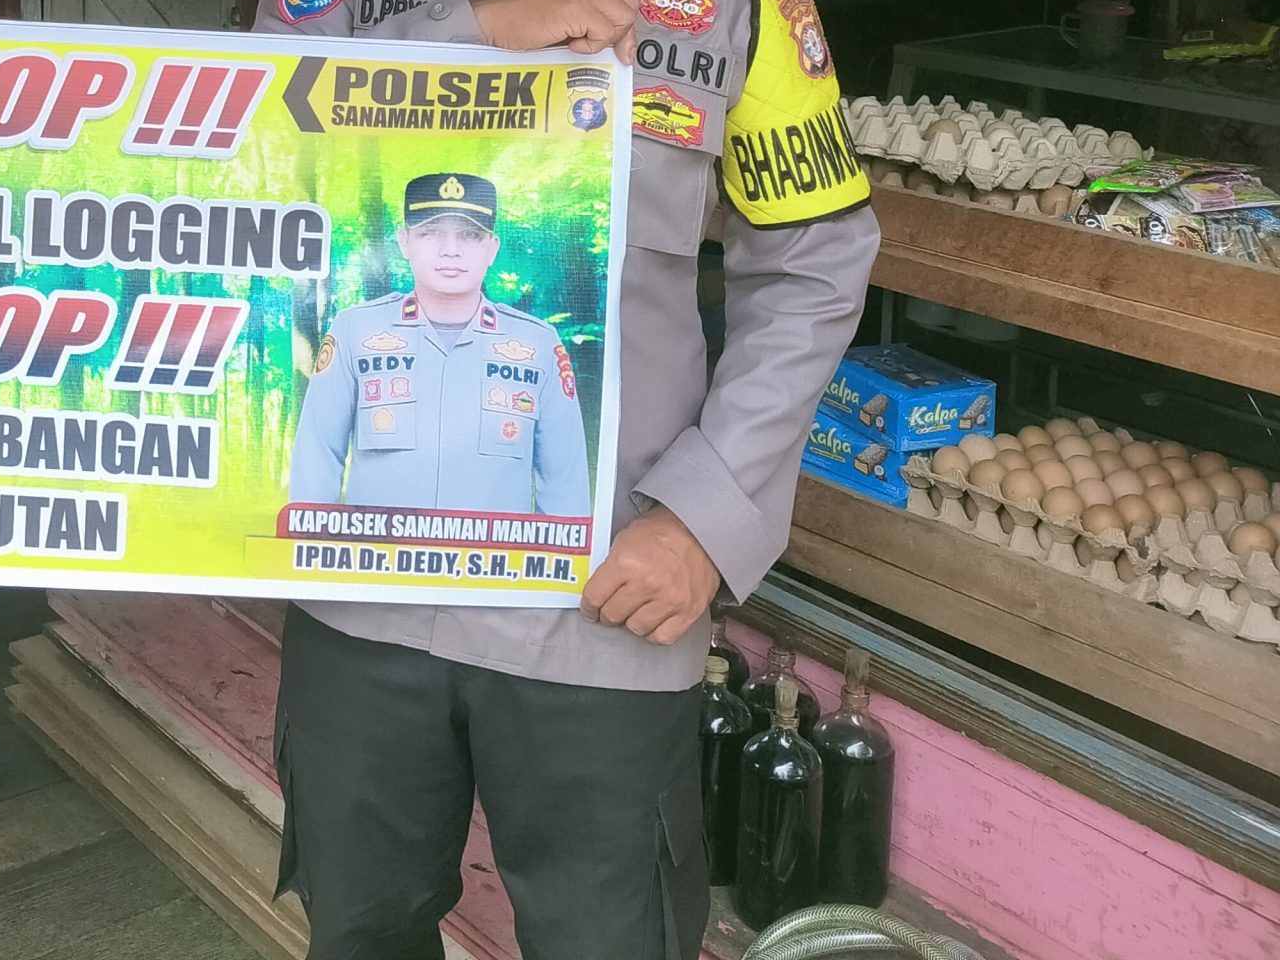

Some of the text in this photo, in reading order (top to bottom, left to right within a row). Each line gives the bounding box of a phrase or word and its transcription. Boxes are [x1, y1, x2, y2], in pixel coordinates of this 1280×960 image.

[636, 39, 727, 89] OLRI
[131, 62, 268, 150] !!!
[333, 65, 542, 109] POLSEK
[330, 106, 536, 131] SANAMAN MANTIKEI
[640, 119, 677, 135] SNIPER
[30, 197, 325, 272] LOGGING
[114, 301, 243, 389] !!!
[357, 354, 415, 375] DEDY
[485, 362, 540, 387] POLRI
[908, 402, 959, 427] Kalpa
[287, 507, 587, 550] KAPOLSEK SANAMAN MANTIKEI
[294, 544, 579, 583] IPDA Dr. DEDY, S.H., M.H.
